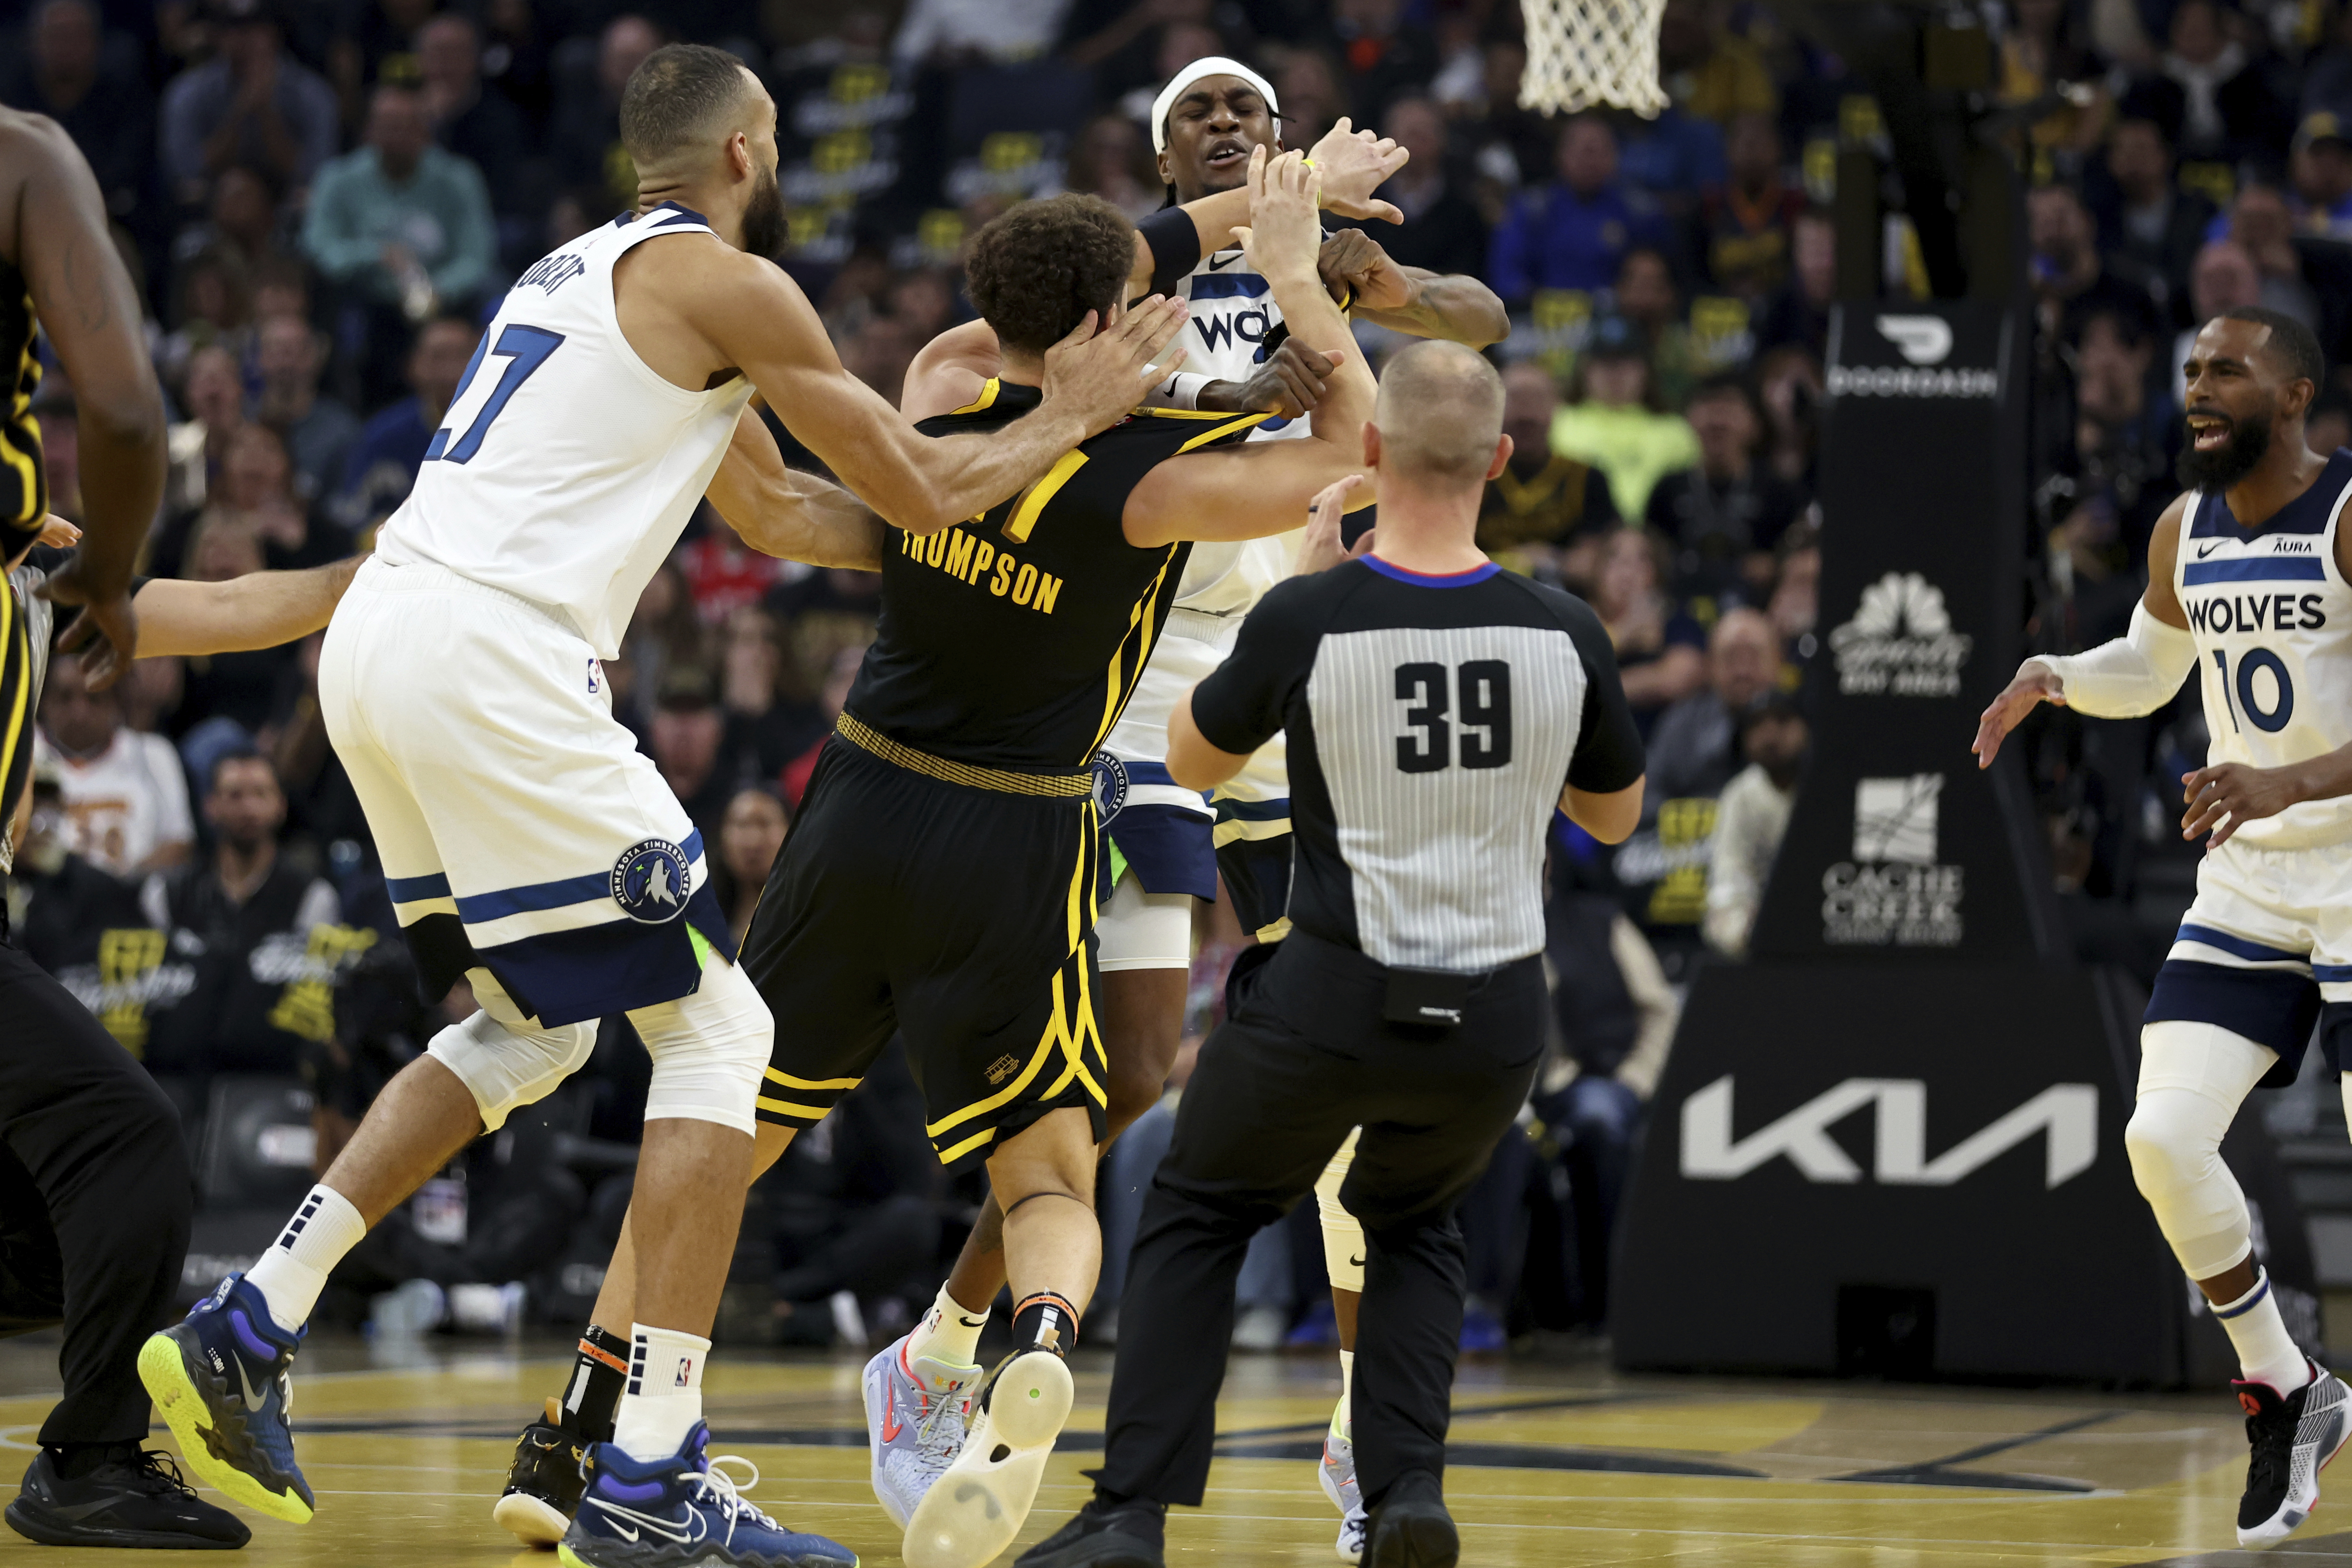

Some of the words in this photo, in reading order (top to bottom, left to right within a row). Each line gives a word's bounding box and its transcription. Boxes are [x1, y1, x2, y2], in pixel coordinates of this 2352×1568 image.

[508, 254, 585, 297] OBERT
[901, 528, 1063, 614] THOMPSON
[2186, 594, 2326, 635] WOLVES
[1395, 659, 1512, 773] 39
[2213, 647, 2294, 734] 10
[1096, 752, 1126, 810] IMBERWOLVES
[614, 848, 641, 905] MINNESOTA
[644, 841, 689, 896] TIMBERWOLVES
